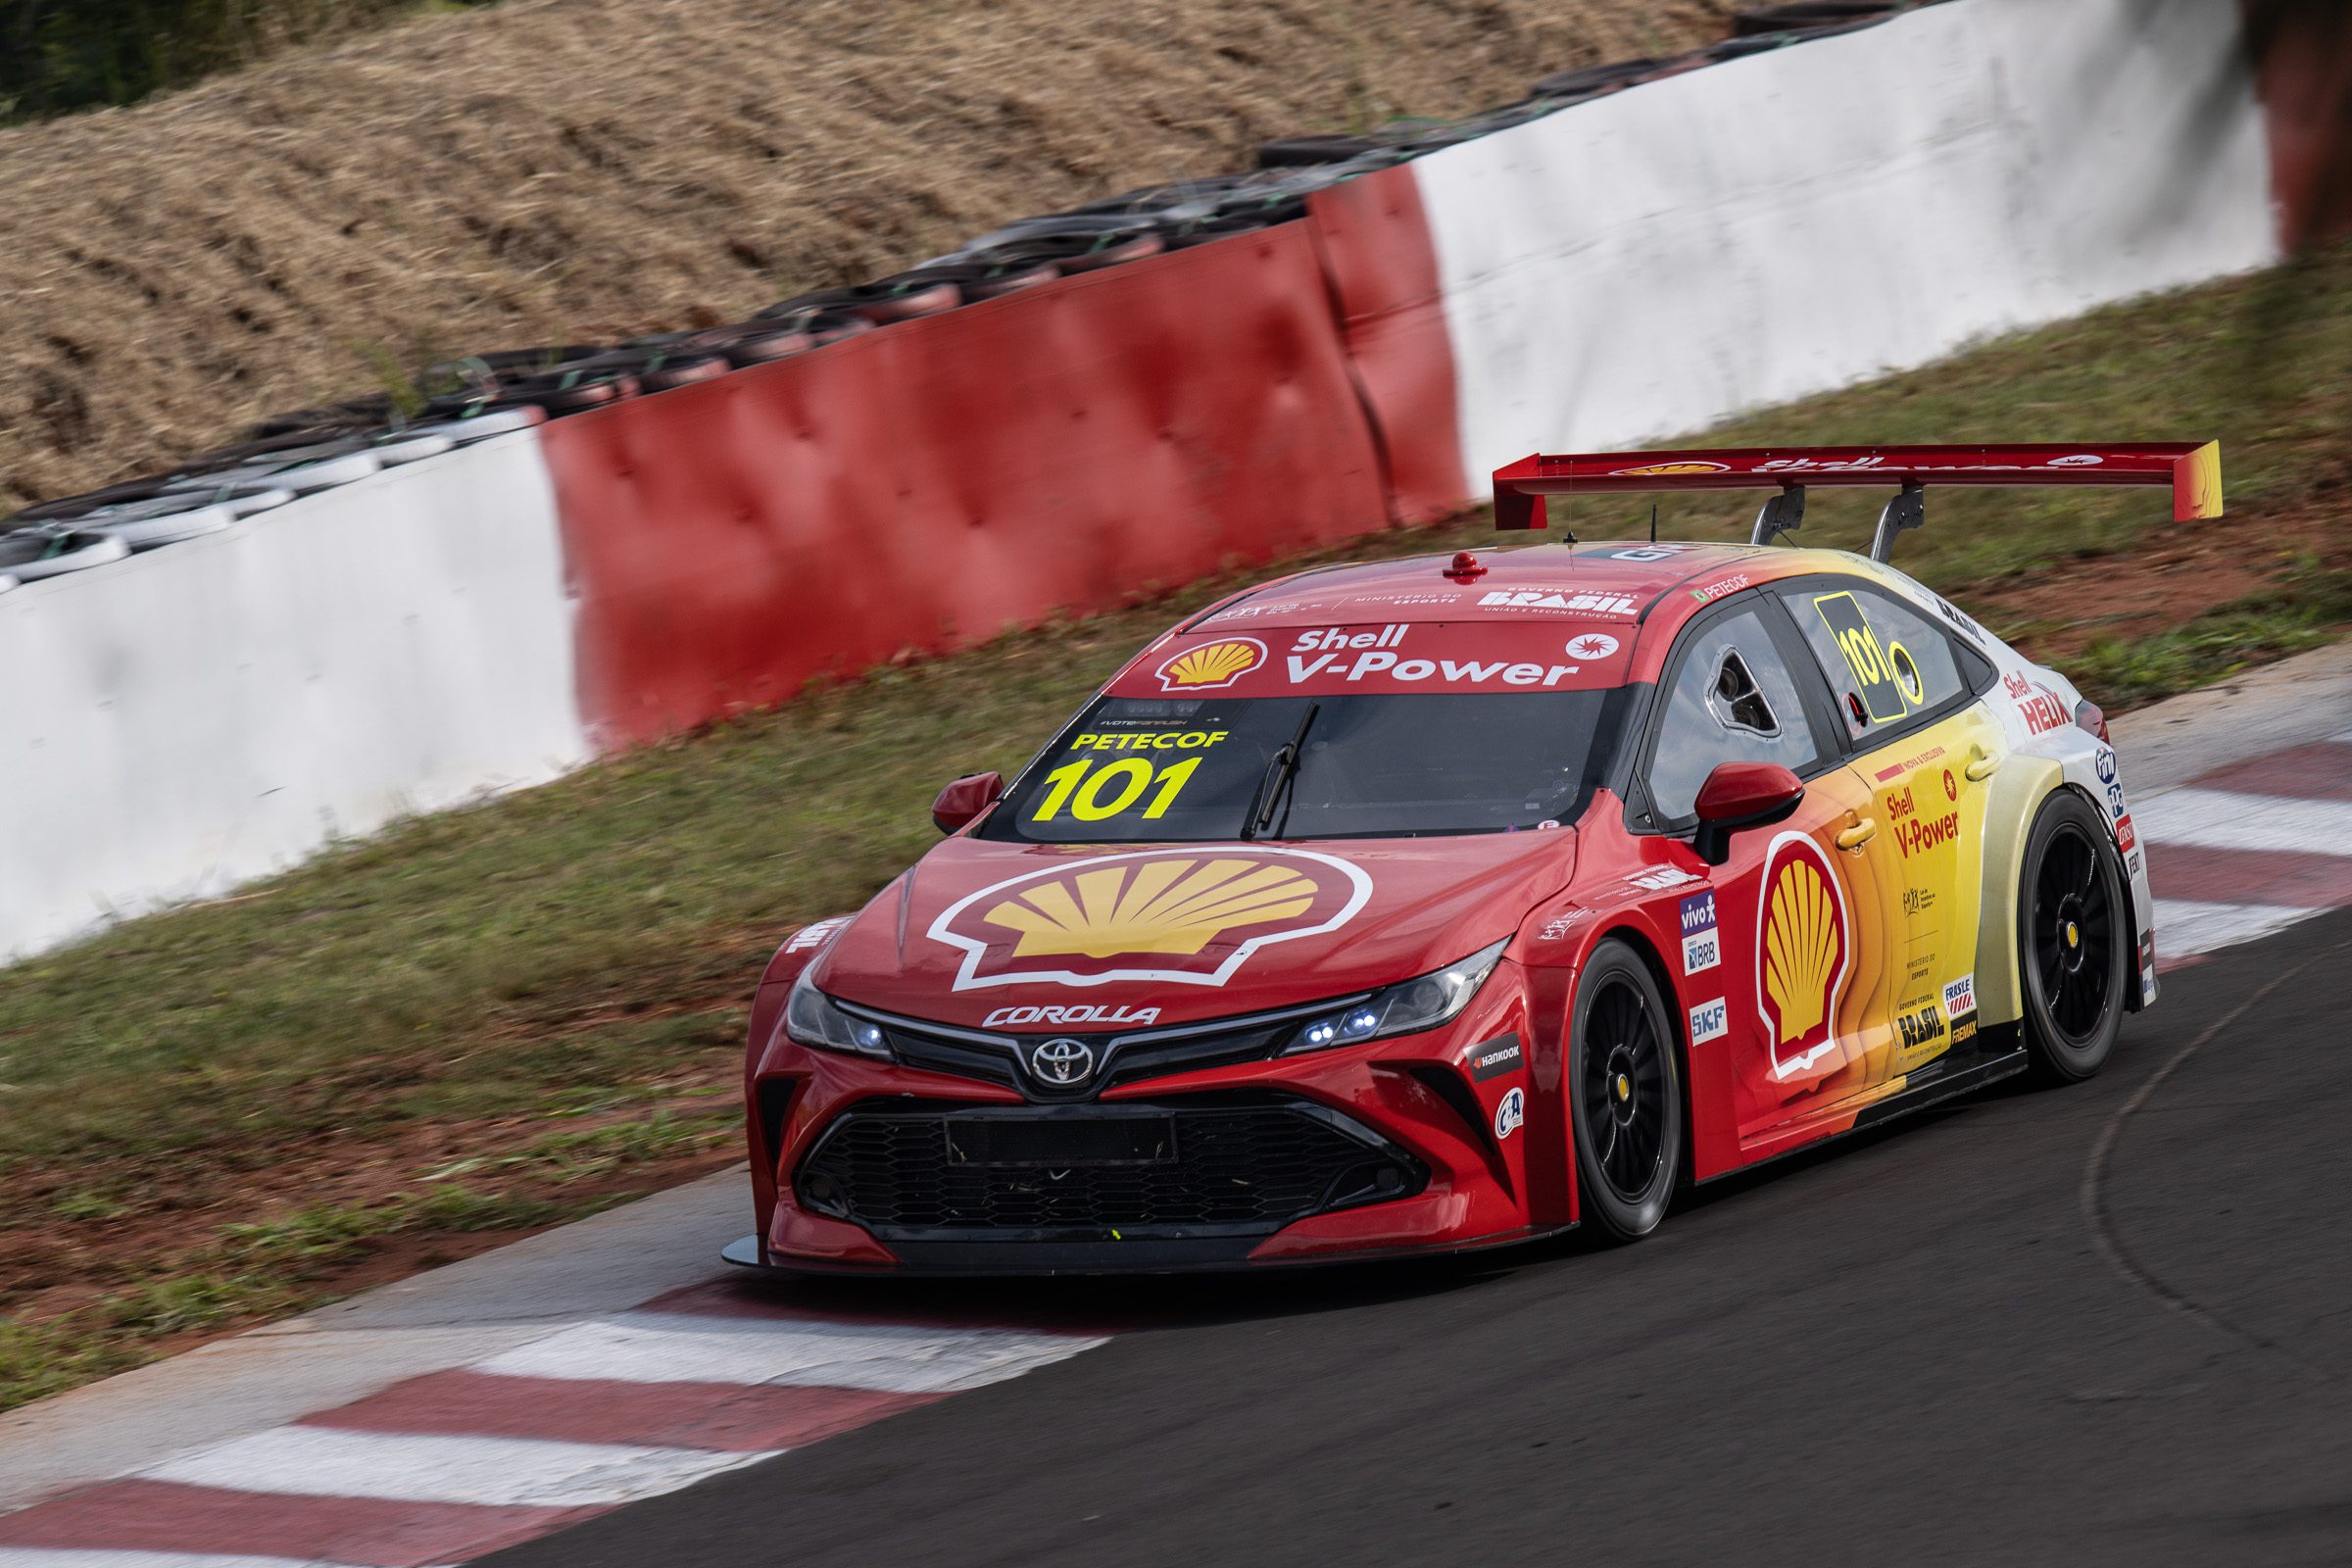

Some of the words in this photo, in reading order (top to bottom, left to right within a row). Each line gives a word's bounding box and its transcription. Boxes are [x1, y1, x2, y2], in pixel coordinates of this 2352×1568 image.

[1703, 574, 1750, 600] PETECOF
[1476, 591, 1640, 615] BRASIL
[1291, 623, 1410, 652] Shell
[1286, 651, 1580, 686] V-Power
[1839, 625, 1891, 687] 101
[2003, 670, 2033, 699] Shell
[2017, 692, 2074, 736] HELIX
[1070, 731, 1229, 751] PETECOF
[1031, 756, 1203, 822] 101
[1886, 786, 1915, 821] Shell
[1893, 810, 1959, 859] V-Power
[1681, 904, 1705, 930] vivo
[1697, 941, 1715, 967] BRB
[982, 1005, 1162, 1028] COROLLA
[1691, 1004, 1725, 1039] SKF
[1897, 1005, 1945, 1050] BRASIL
[1951, 1020, 1977, 1046] FREMAX
